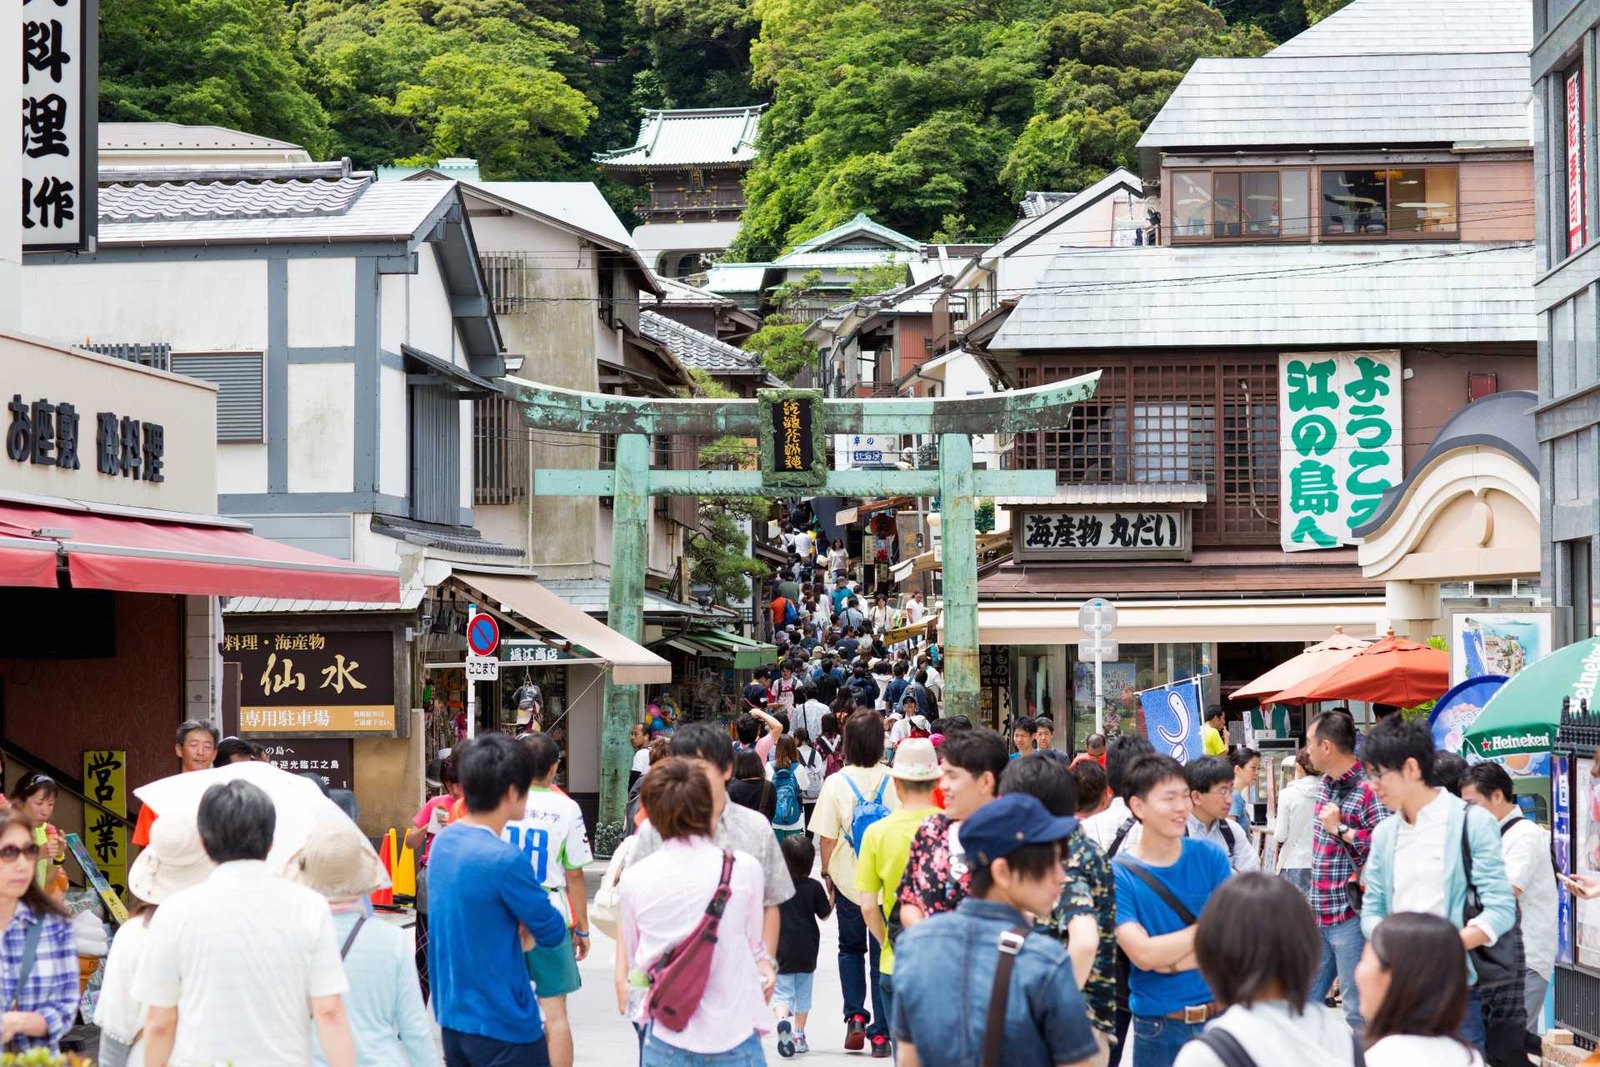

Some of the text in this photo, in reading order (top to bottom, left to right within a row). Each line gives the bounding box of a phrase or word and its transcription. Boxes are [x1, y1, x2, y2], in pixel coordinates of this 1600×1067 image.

[22, 0, 71, 158] 料理
[6, 394, 80, 470] お座敷
[1287, 359, 1340, 547] 江の島へ
[1026, 513, 1178, 548] 海産物 丸だい
[468, 663, 497, 675] ここまで
[240, 709, 330, 727] 専用駐車場
[1492, 732, 1549, 750] Heineken
